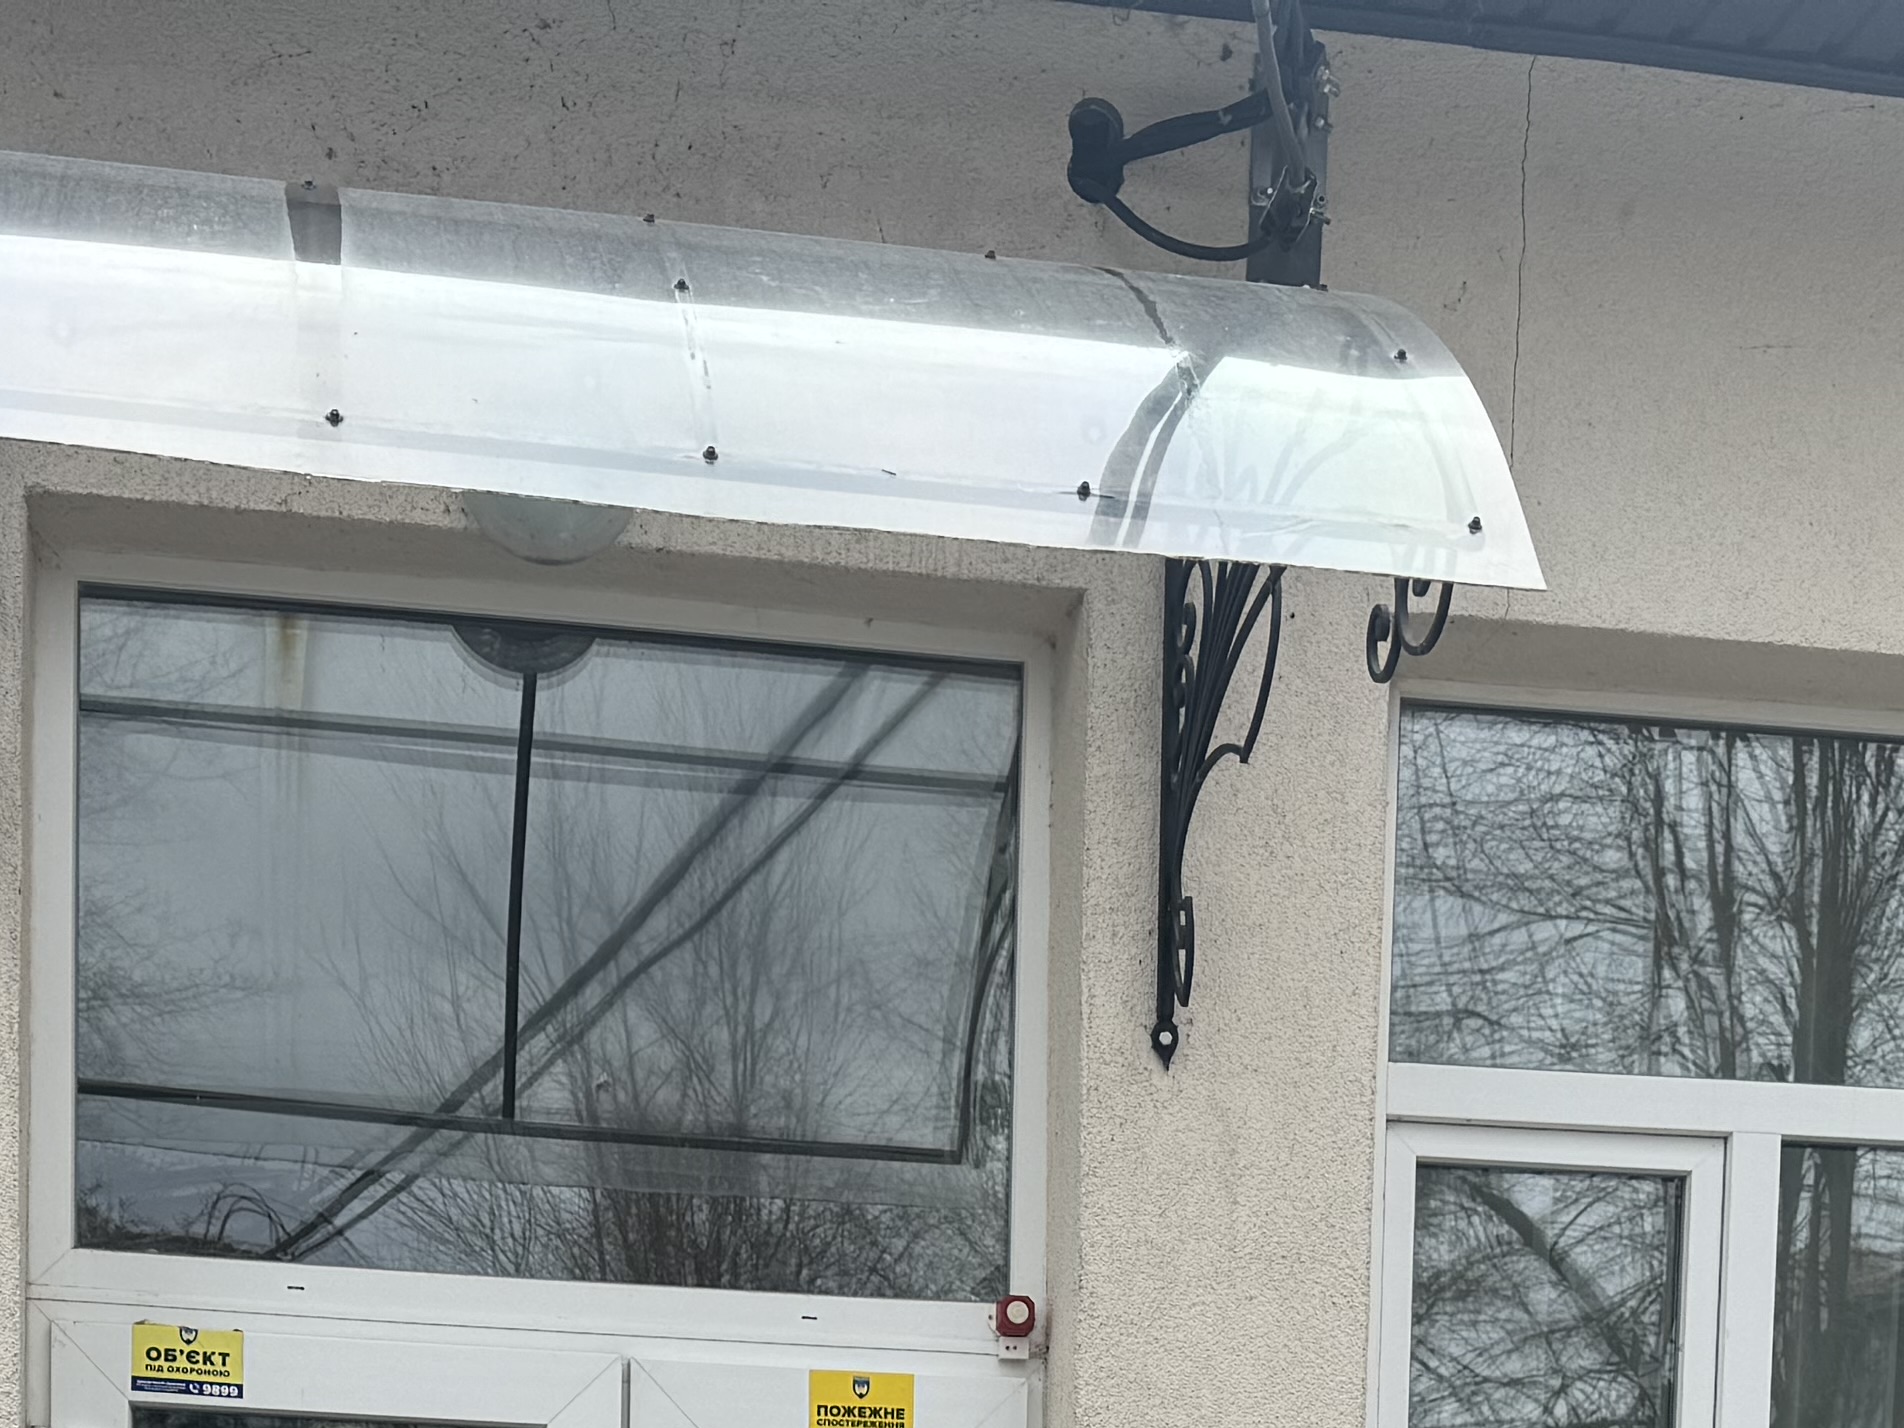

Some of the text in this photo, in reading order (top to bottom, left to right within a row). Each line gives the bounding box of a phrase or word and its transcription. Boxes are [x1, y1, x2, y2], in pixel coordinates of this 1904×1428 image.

[145, 1363, 230, 1378] ПІД ОХОРОНОЮ
[202, 1383, 238, 1397] 9899
[816, 1404, 905, 1420] ПОЖЕЖНЕ
